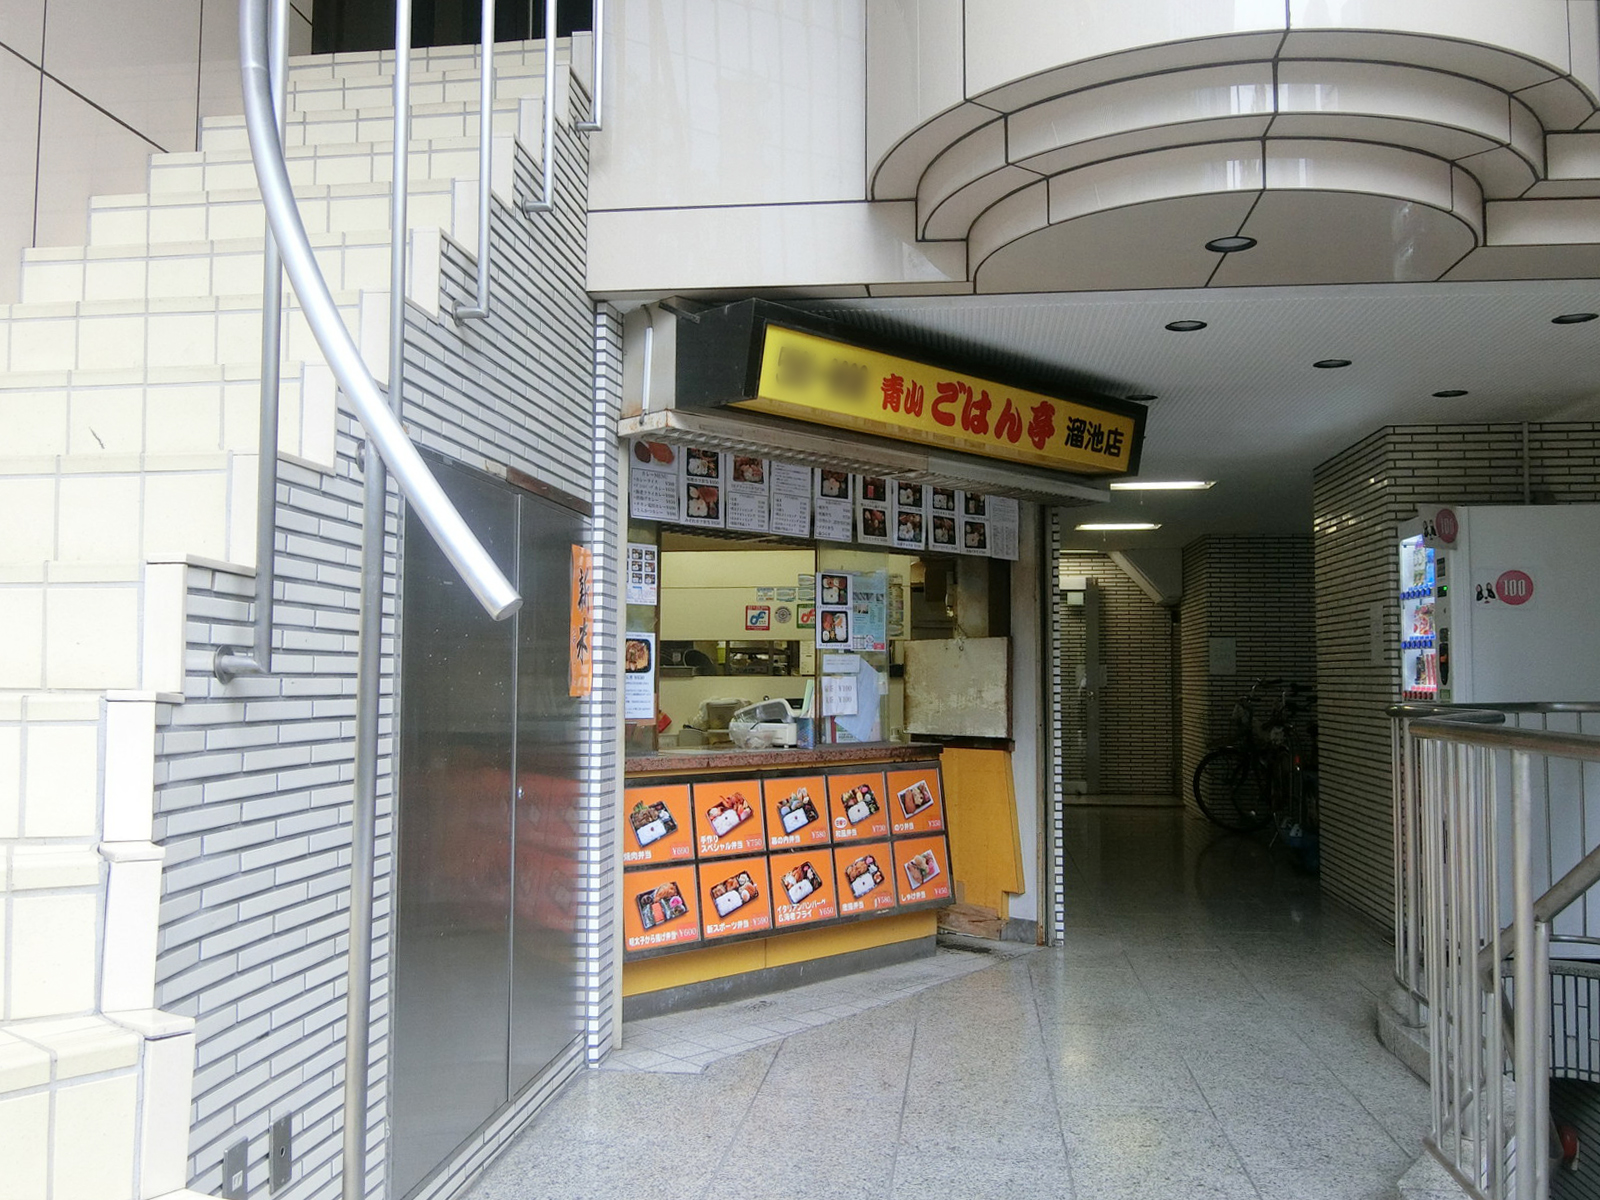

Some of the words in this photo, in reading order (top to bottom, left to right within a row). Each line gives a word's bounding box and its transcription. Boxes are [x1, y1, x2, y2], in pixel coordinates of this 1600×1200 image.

[881, 373, 924, 417] 青山
[931, 381, 1056, 450] ごはん亭
[1065, 416, 1125, 458] 溜池店
[1503, 579, 1526, 597] 100
[700, 835, 719, 844] 手作り
[701, 841, 743, 852] スペシャル弁当
